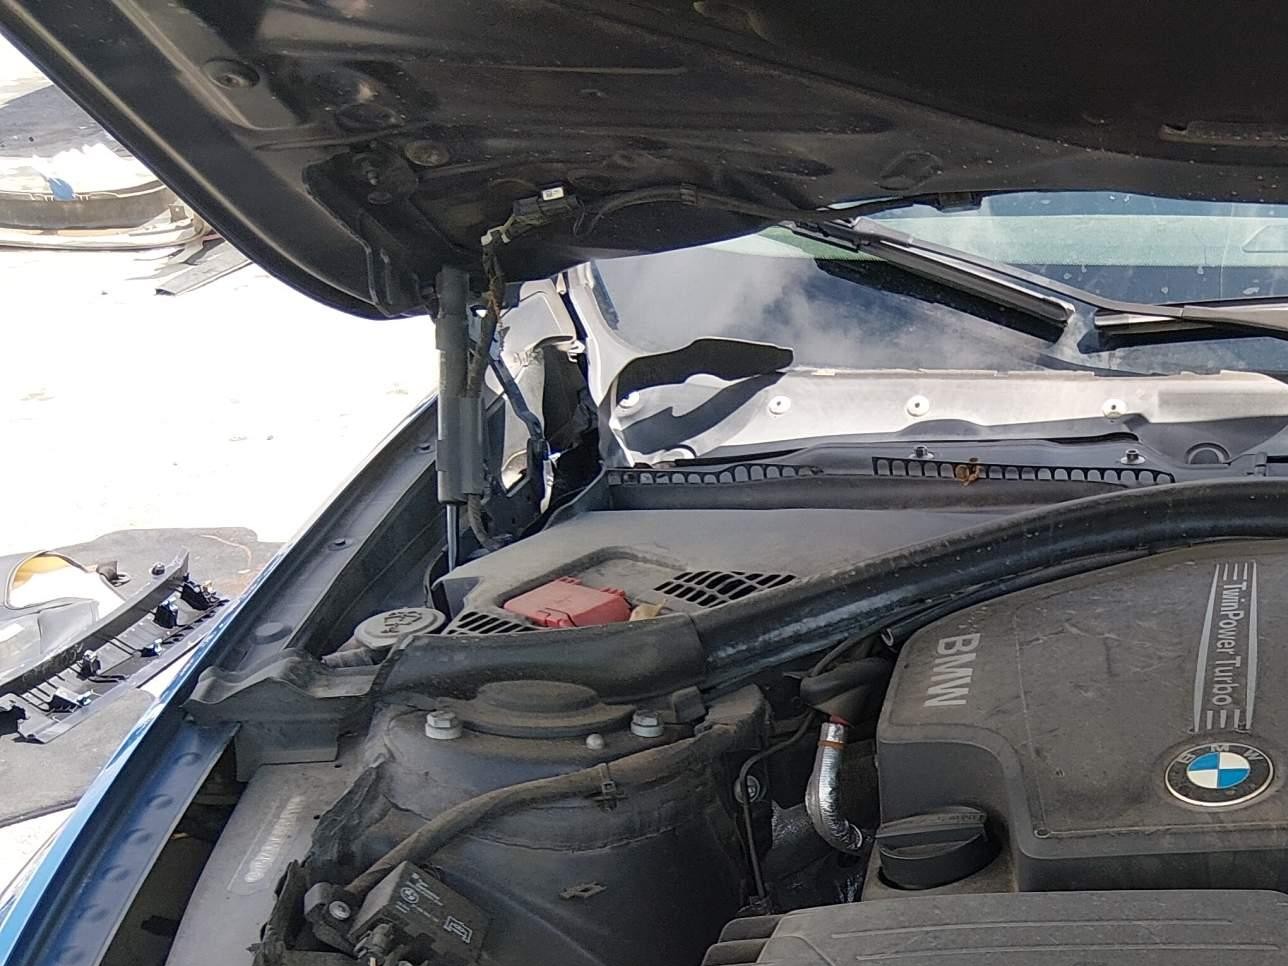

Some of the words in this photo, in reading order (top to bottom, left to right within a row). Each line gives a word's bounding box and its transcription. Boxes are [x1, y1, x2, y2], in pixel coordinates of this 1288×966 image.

[1216, 582, 1247, 654] TwinPower
[924, 633, 981, 707] BMW
[1212, 655, 1242, 706] Turbo
[1176, 743, 1264, 764] BMW
